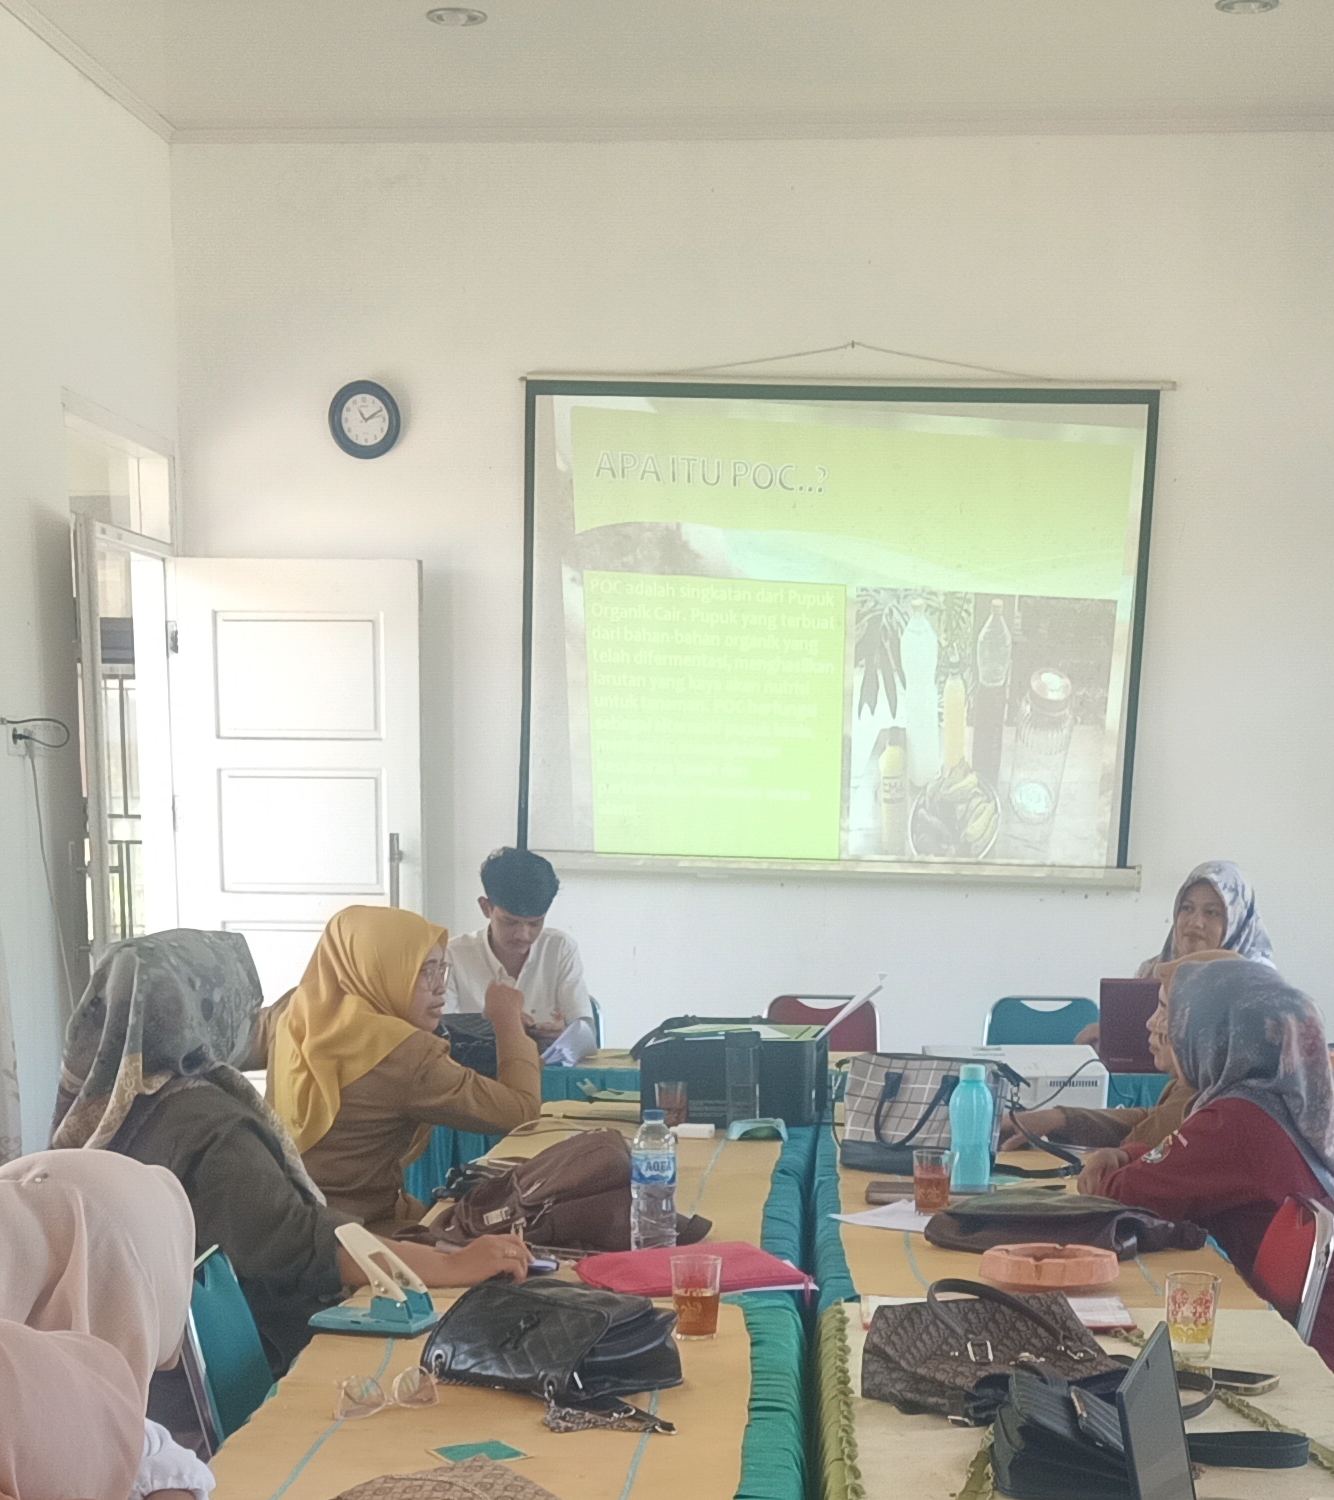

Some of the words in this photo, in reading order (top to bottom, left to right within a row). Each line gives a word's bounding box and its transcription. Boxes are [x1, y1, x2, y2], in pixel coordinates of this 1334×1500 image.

[596, 451, 661, 483] APA
[671, 456, 721, 486] ITU
[590, 579, 625, 595] POC
[626, 582, 675, 598] adalah
[680, 585, 751, 603] singkatan
[756, 588, 783, 603] dari
[788, 589, 834, 609] Pupuk
[591, 602, 650, 622] Organik
[654, 607, 687, 622] Cair.
[692, 610, 737, 628] Pupuk
[742, 614, 777, 631] yang
[782, 613, 835, 630] terbuat
[592, 625, 620, 640] dari
[624, 627, 721, 647] bahan-bahan
[725, 635, 779, 651] organik
[784, 639, 819, 655] yang
[593, 648, 630, 663] telah
[735, 658, 835, 674] menghasilkan
[593, 671, 646, 687] larutan
[650, 676, 684, 693] yang
[594, 694, 638, 709] untuk
